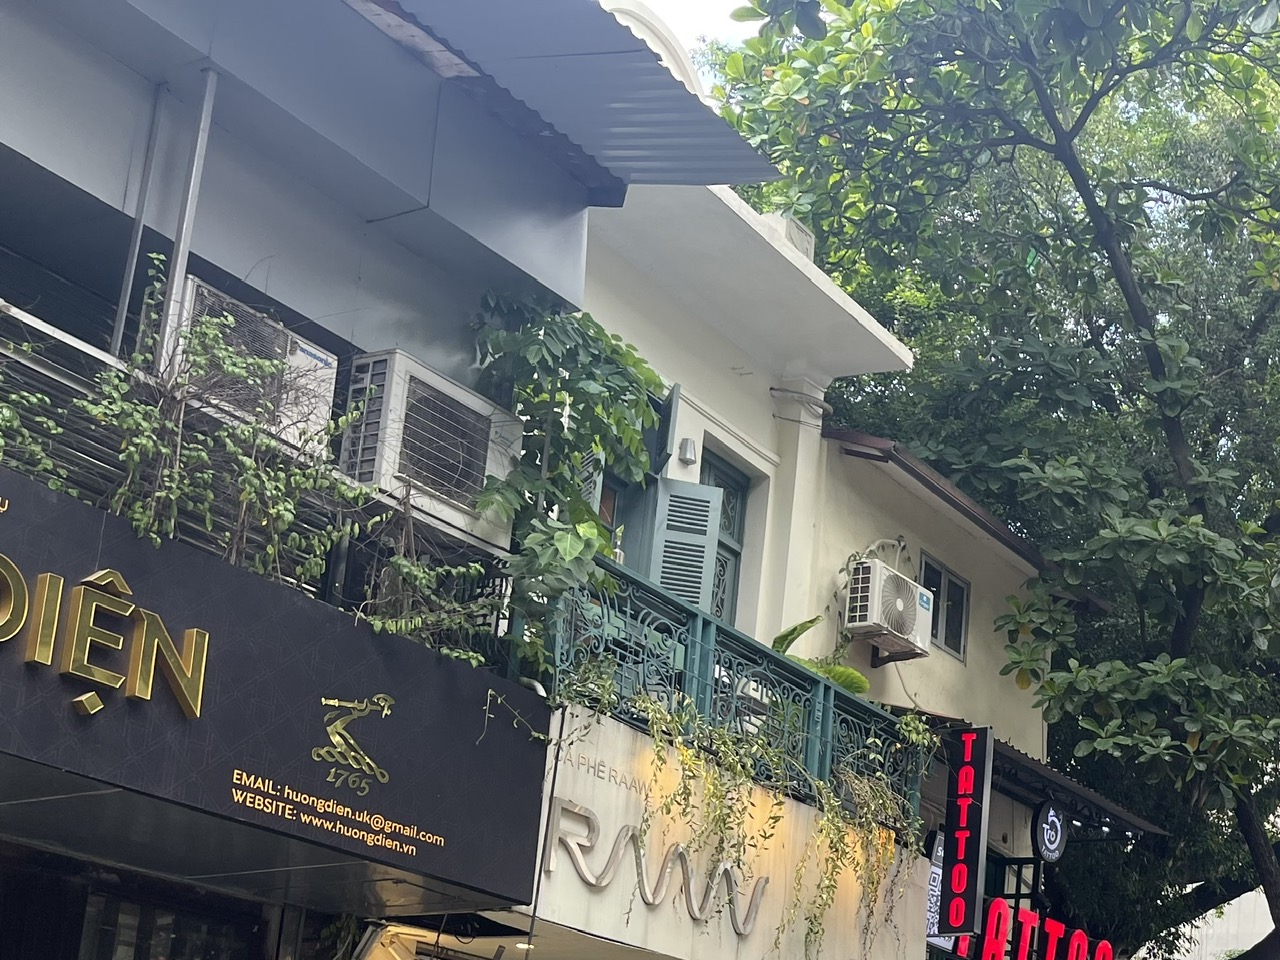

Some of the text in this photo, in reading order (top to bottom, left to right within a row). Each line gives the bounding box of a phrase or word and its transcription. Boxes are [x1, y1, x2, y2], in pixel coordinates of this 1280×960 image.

[297, 345, 332, 368] anasonic
[326, 767, 373, 796] 1765
[579, 755, 607, 780] PHÊ
[231, 788, 417, 856] WEBSITE: www.huongdien.vn
[232, 769, 445, 847] EMAIL: huongdien.uk@gmail.com
[948, 732, 977, 928] TATTOO
